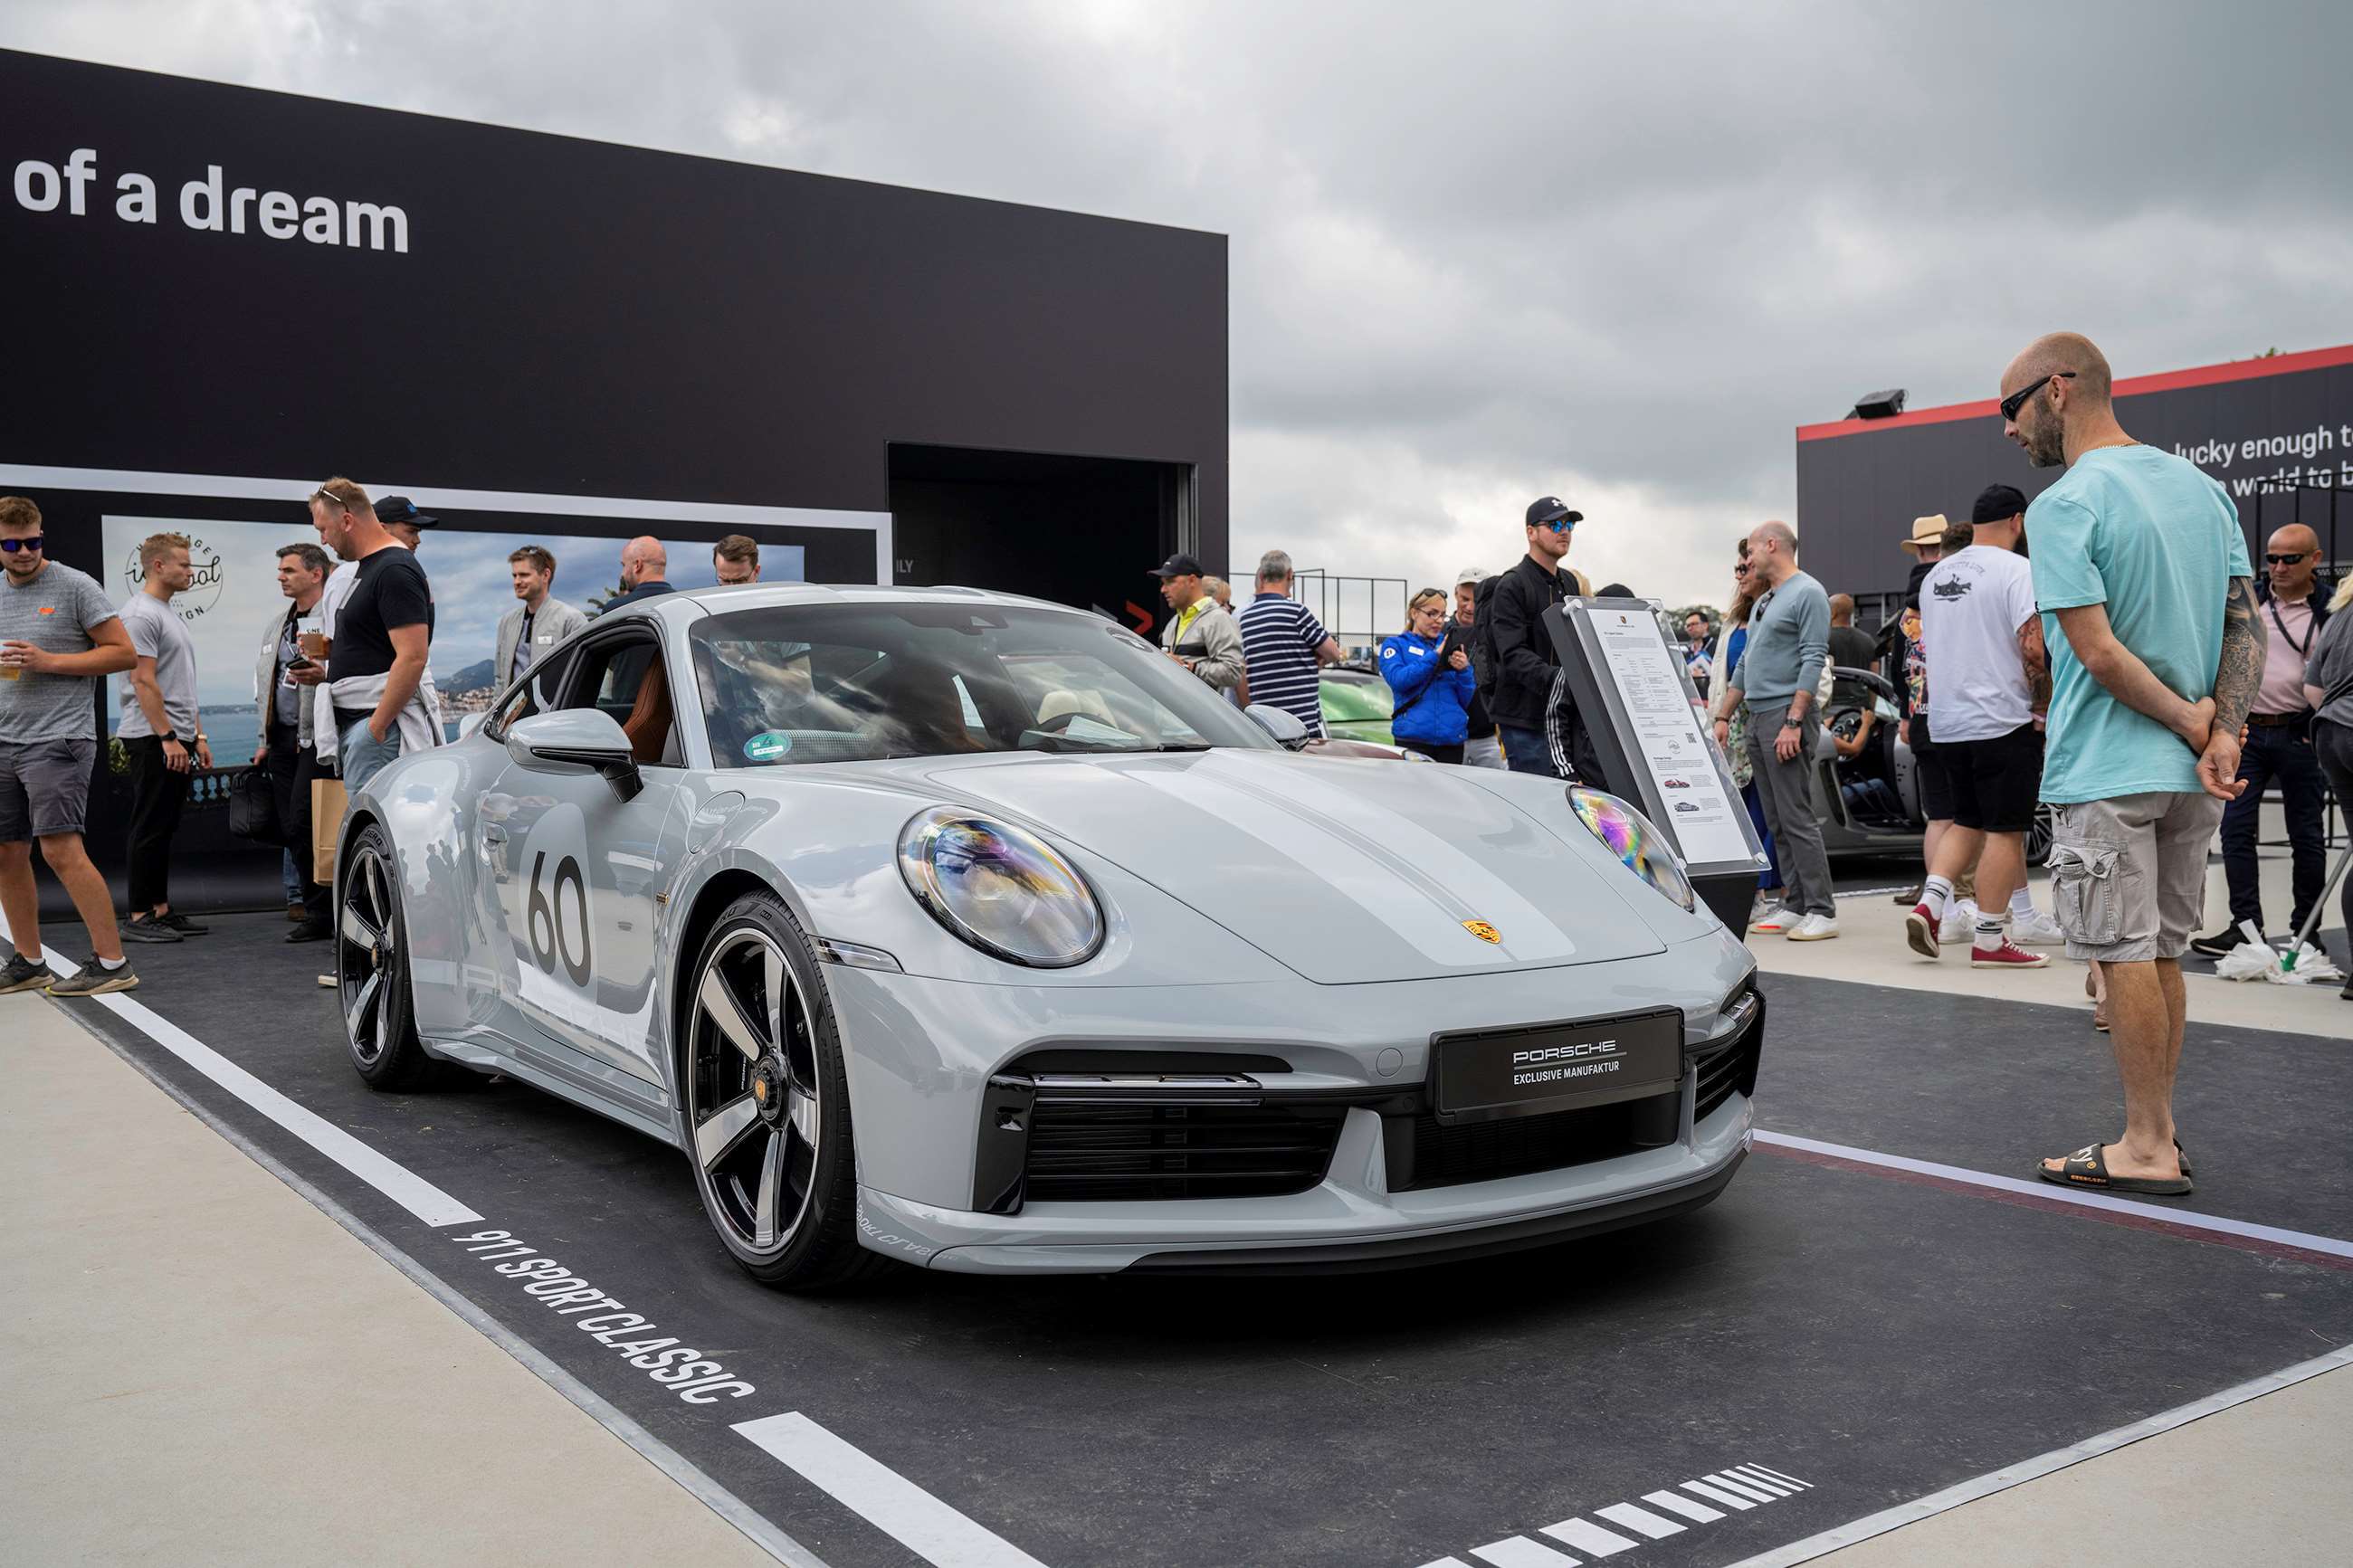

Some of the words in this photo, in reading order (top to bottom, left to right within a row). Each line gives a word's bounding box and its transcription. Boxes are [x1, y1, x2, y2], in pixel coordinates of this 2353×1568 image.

[14, 147, 97, 216] of
[116, 172, 157, 223] a
[179, 164, 409, 253] dream
[2175, 439, 2236, 469] lucky
[2241, 424, 2333, 459] enough
[2340, 424, 2353, 447] t
[2233, 465, 2301, 498] world
[2307, 467, 2332, 489] to
[528, 851, 592, 987] 60
[1513, 1040, 1616, 1063] PORSCHE
[1513, 1069, 1562, 1085] EXCLUSIVE
[1563, 1060, 1620, 1079] MANUFAKTUR
[452, 1230, 538, 1260] 911
[494, 1258, 626, 1315] SPORT
[576, 1313, 757, 1404] CLASSIC
